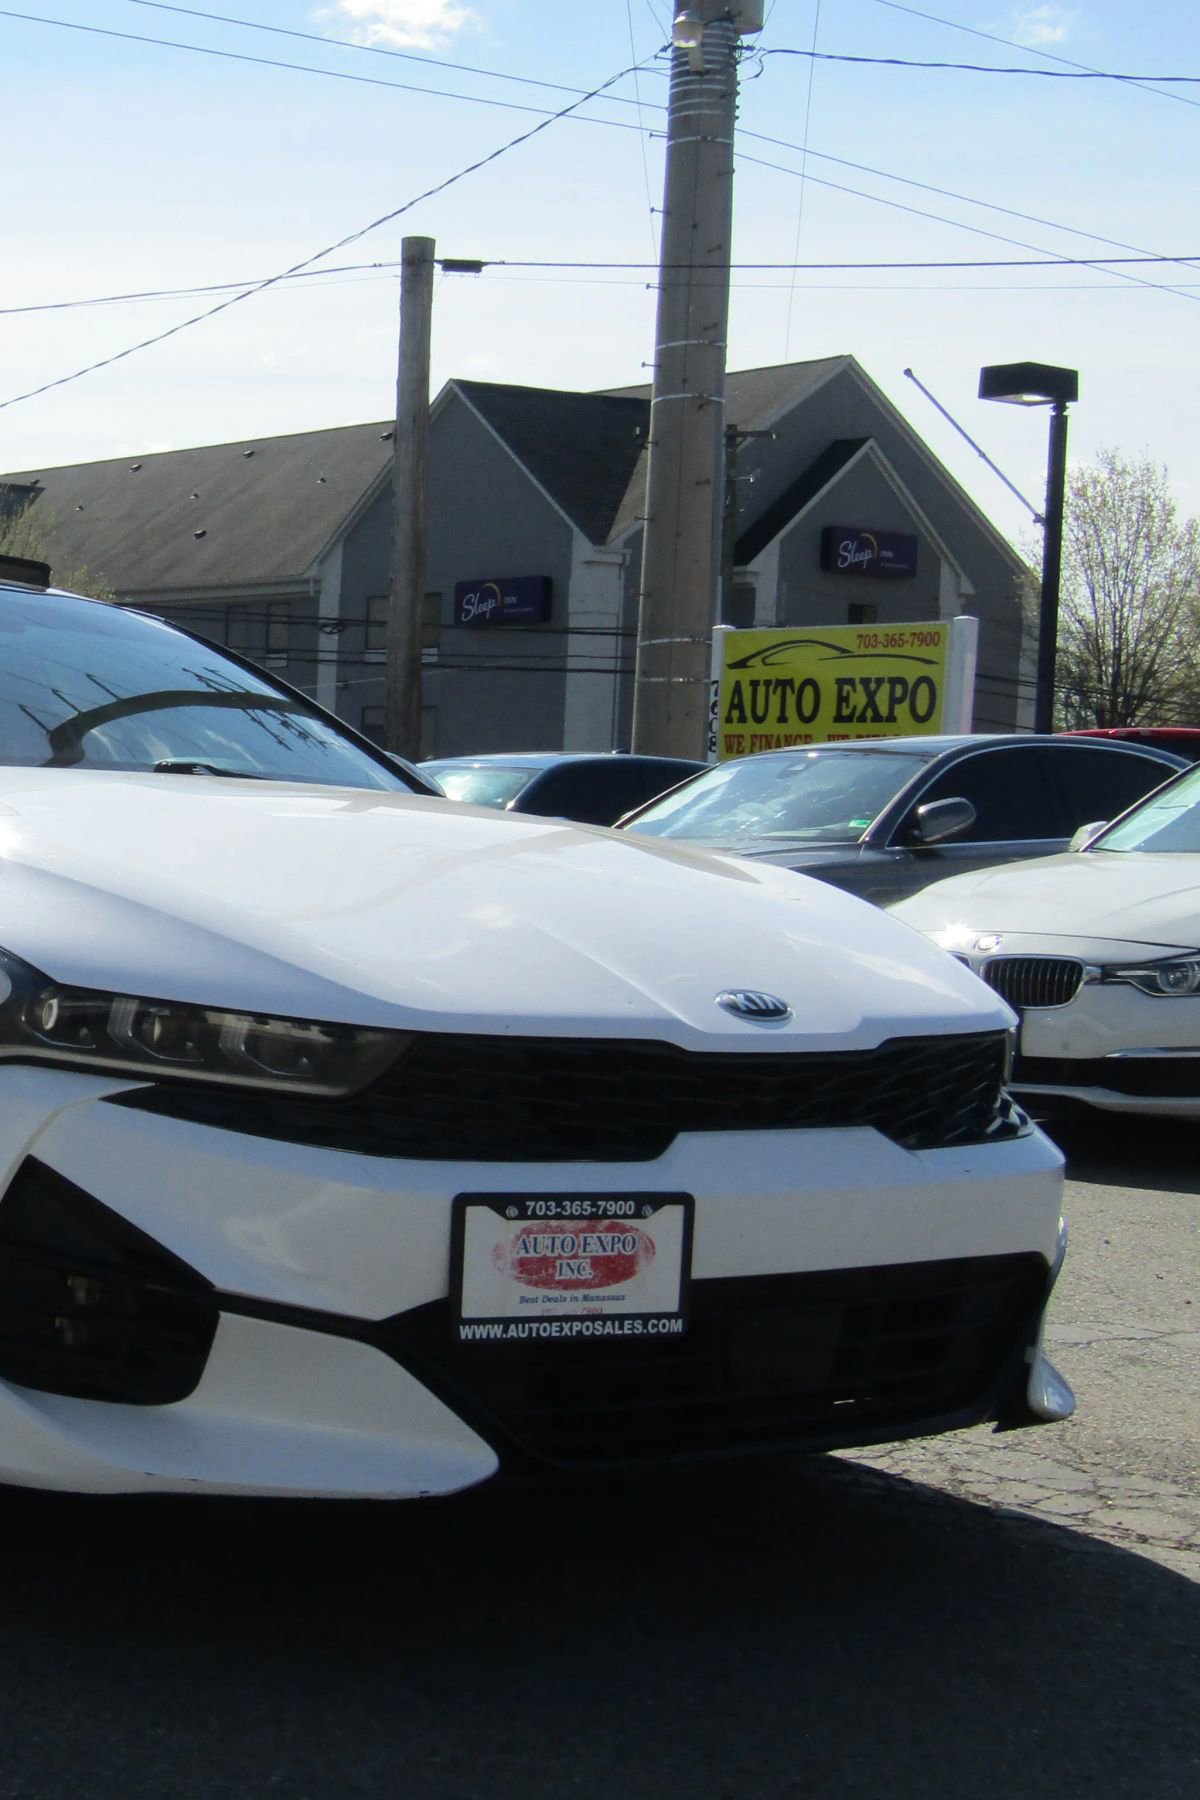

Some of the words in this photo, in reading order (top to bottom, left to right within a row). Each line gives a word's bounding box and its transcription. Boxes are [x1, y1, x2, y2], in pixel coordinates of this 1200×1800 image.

[838, 540, 873, 569] Sleep
[461, 592, 497, 622] Sleep
[857, 631, 941, 649] 703-365-7900
[724, 677, 821, 724] AUTO
[832, 675, 937, 724] EXPO
[724, 734, 746, 755] WE
[734, 993, 786, 1011] KIA
[525, 1200, 636, 1217] 703-365-7900
[517, 1236, 576, 1255] AUTO
[582, 1234, 638, 1254] EXPO
[557, 1260, 593, 1279] INC.
[519, 1295, 539, 1304] Best
[542, 1294, 567, 1303] Deals
[570, 1294, 579, 1302] in
[459, 1318, 683, 1340] WWW.AUTOEXPOSALES.COM
